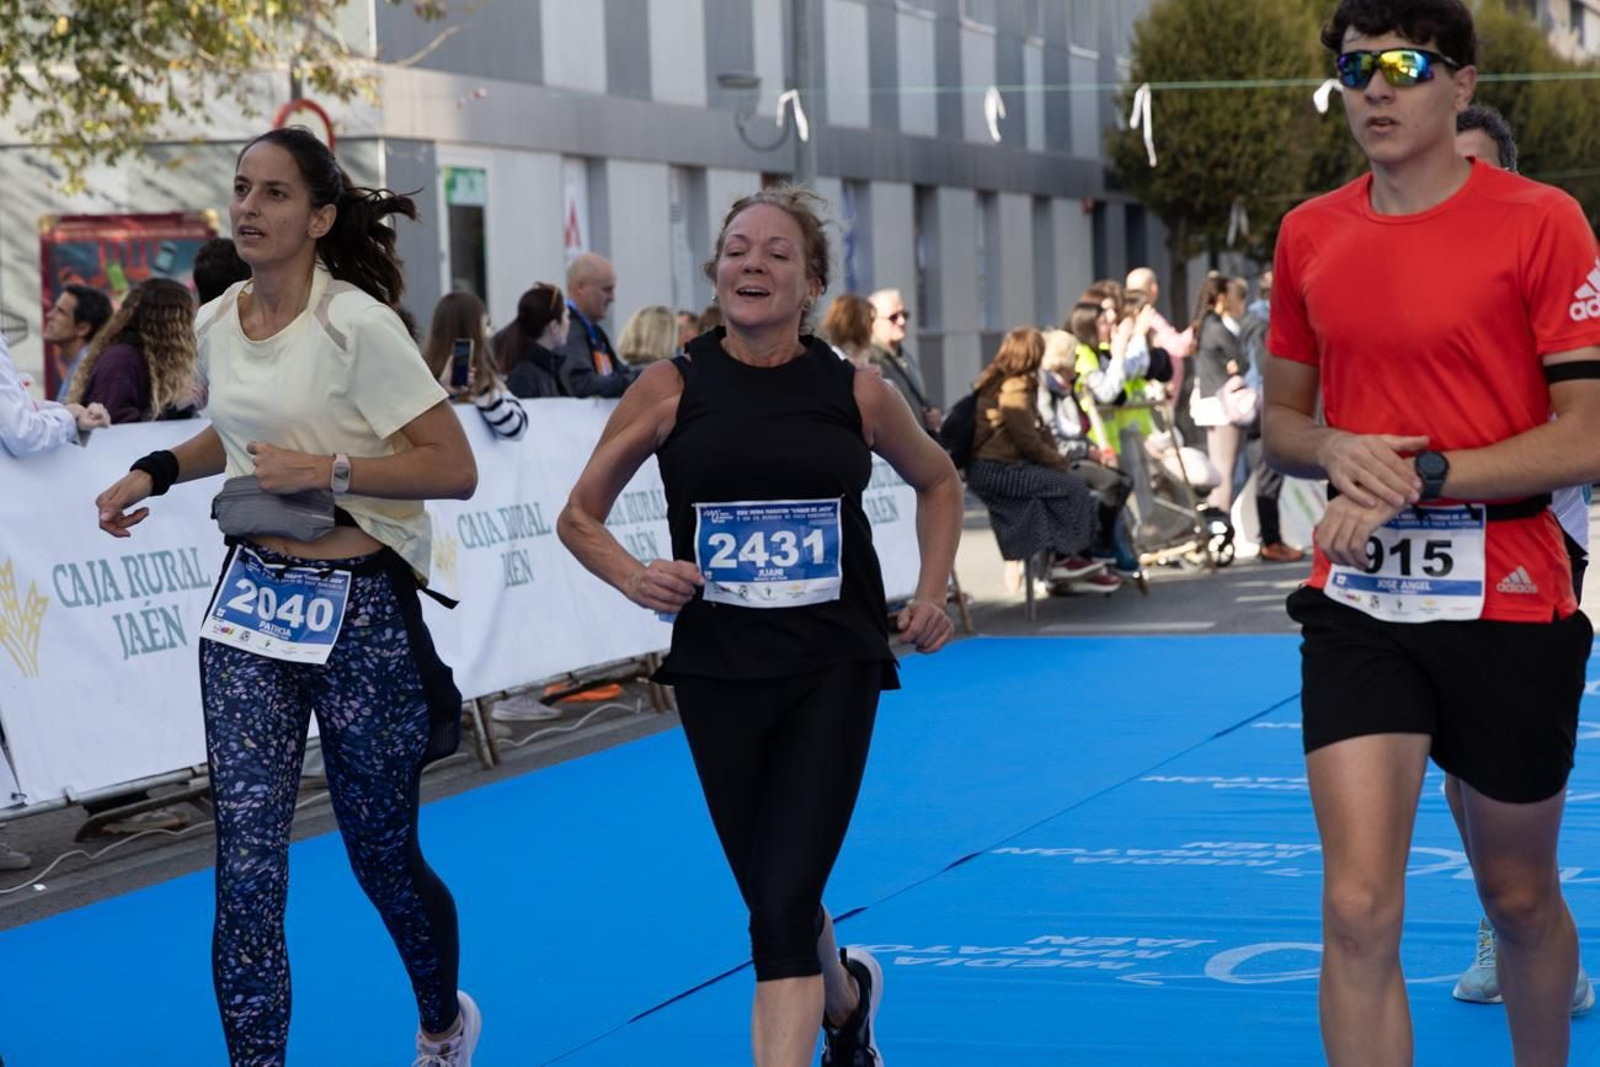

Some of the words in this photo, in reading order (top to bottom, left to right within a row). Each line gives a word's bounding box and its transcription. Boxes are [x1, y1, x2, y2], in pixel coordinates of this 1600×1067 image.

[457, 511, 506, 549] CAJA
[708, 529, 824, 568] 2431
[1365, 535, 1454, 577] 915
[52, 559, 125, 608] CAJA
[119, 547, 212, 599] RURAL
[226, 578, 334, 632] 2040
[112, 600, 188, 660] JAÉN
[892, 956, 1138, 970] MEDIA
